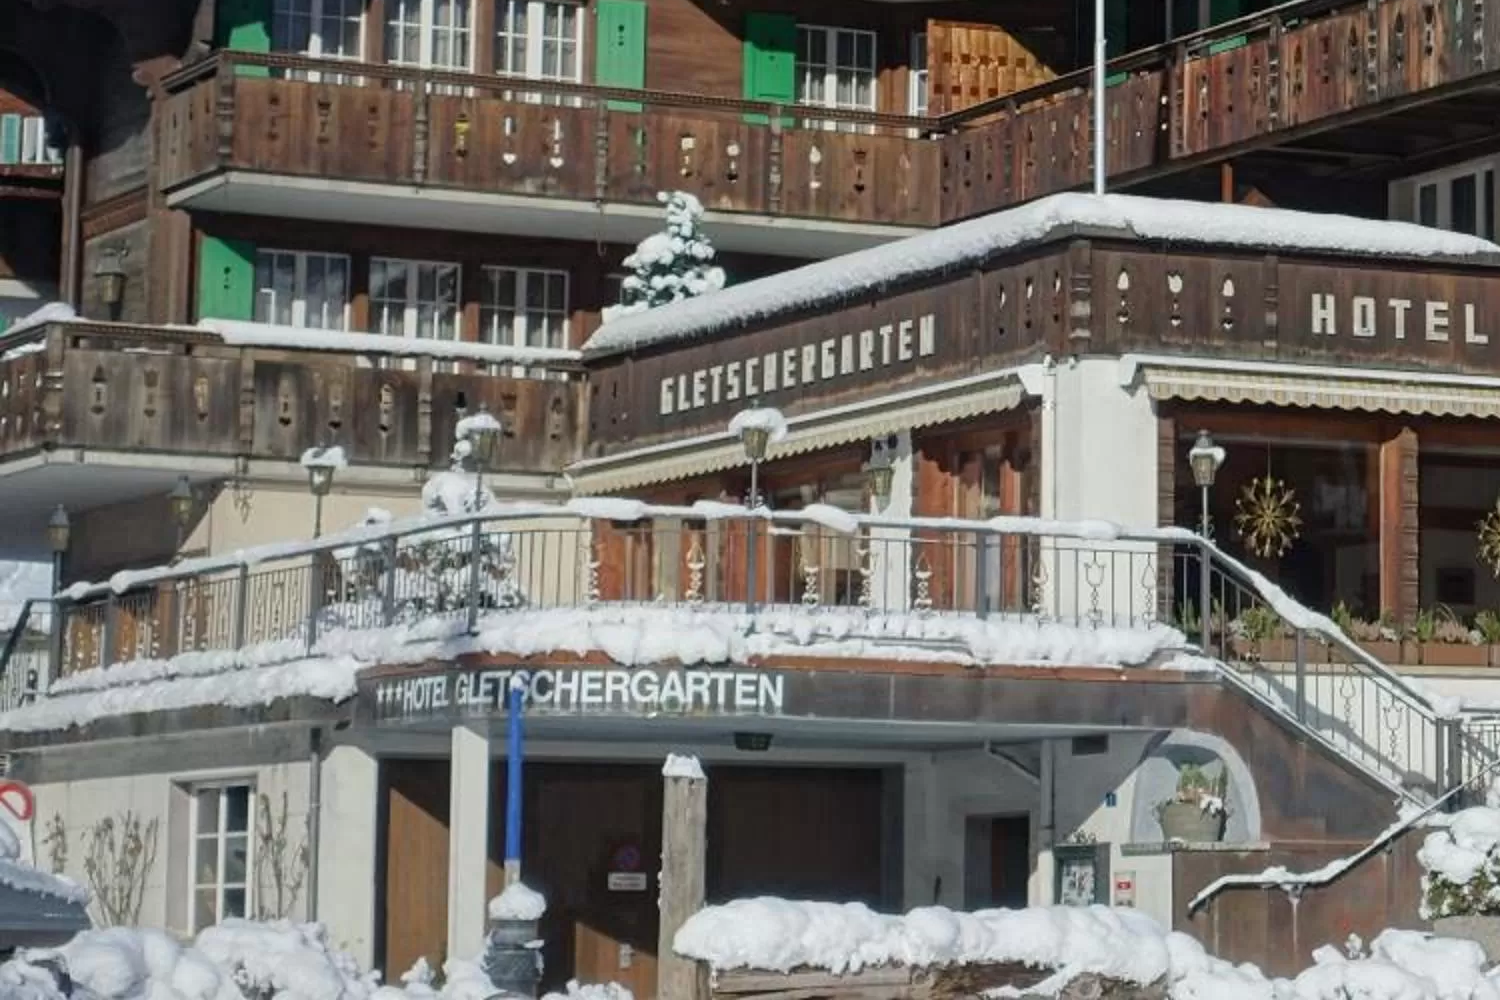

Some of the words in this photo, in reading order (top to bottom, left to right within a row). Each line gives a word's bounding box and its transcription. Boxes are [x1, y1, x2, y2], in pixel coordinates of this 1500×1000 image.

[1311, 293, 1489, 345] HOTEL
[659, 313, 935, 415] GLETSCHERGARTEN
[403, 674, 449, 712] HOTEL
